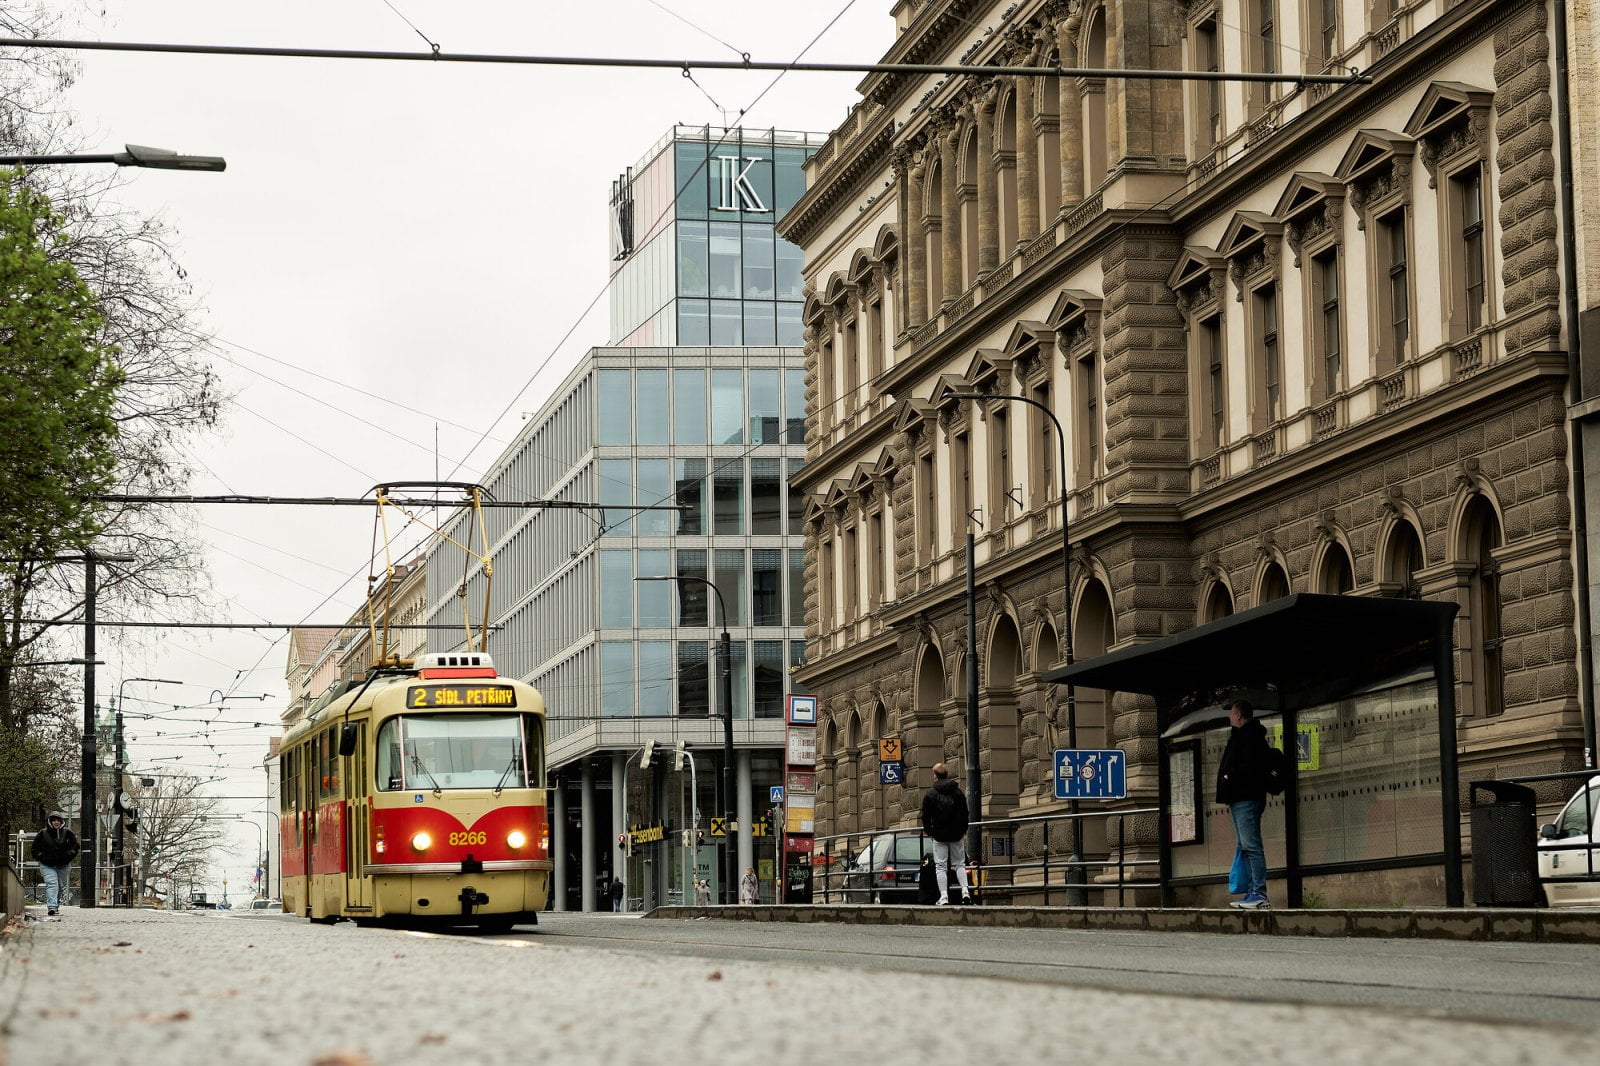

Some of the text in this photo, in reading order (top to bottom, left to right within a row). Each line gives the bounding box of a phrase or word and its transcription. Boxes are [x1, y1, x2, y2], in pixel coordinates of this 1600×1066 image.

[717, 156, 769, 212] K
[413, 687, 513, 706] 2 SÍDL. PETŘINY
[449, 831, 487, 846] 8266
